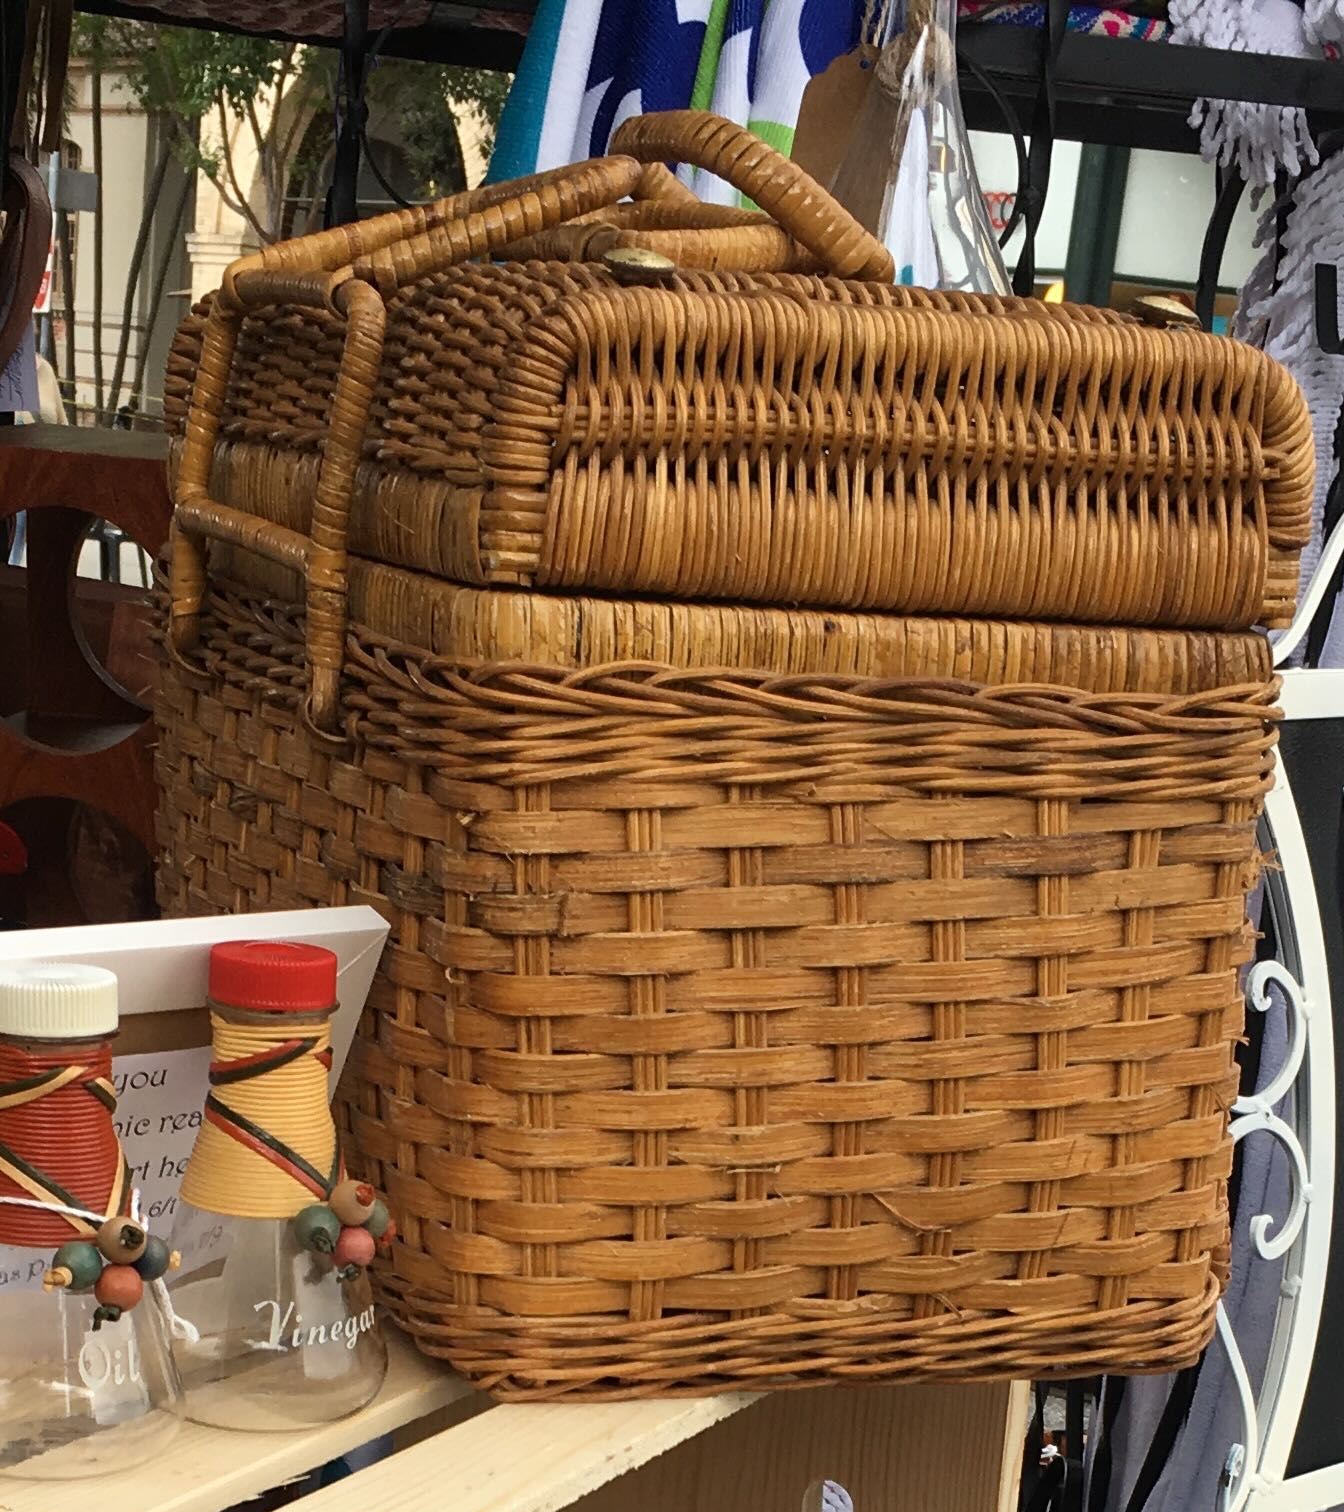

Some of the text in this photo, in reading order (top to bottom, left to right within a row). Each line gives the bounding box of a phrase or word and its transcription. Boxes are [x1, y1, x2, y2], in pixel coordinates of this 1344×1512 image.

[113, 1068, 168, 1099] you
[159, 1110, 203, 1135] rea
[148, 1196, 177, 1218] 6/1
[251, 1299, 376, 1351] Vinegar
[77, 1338, 141, 1389] Oil
